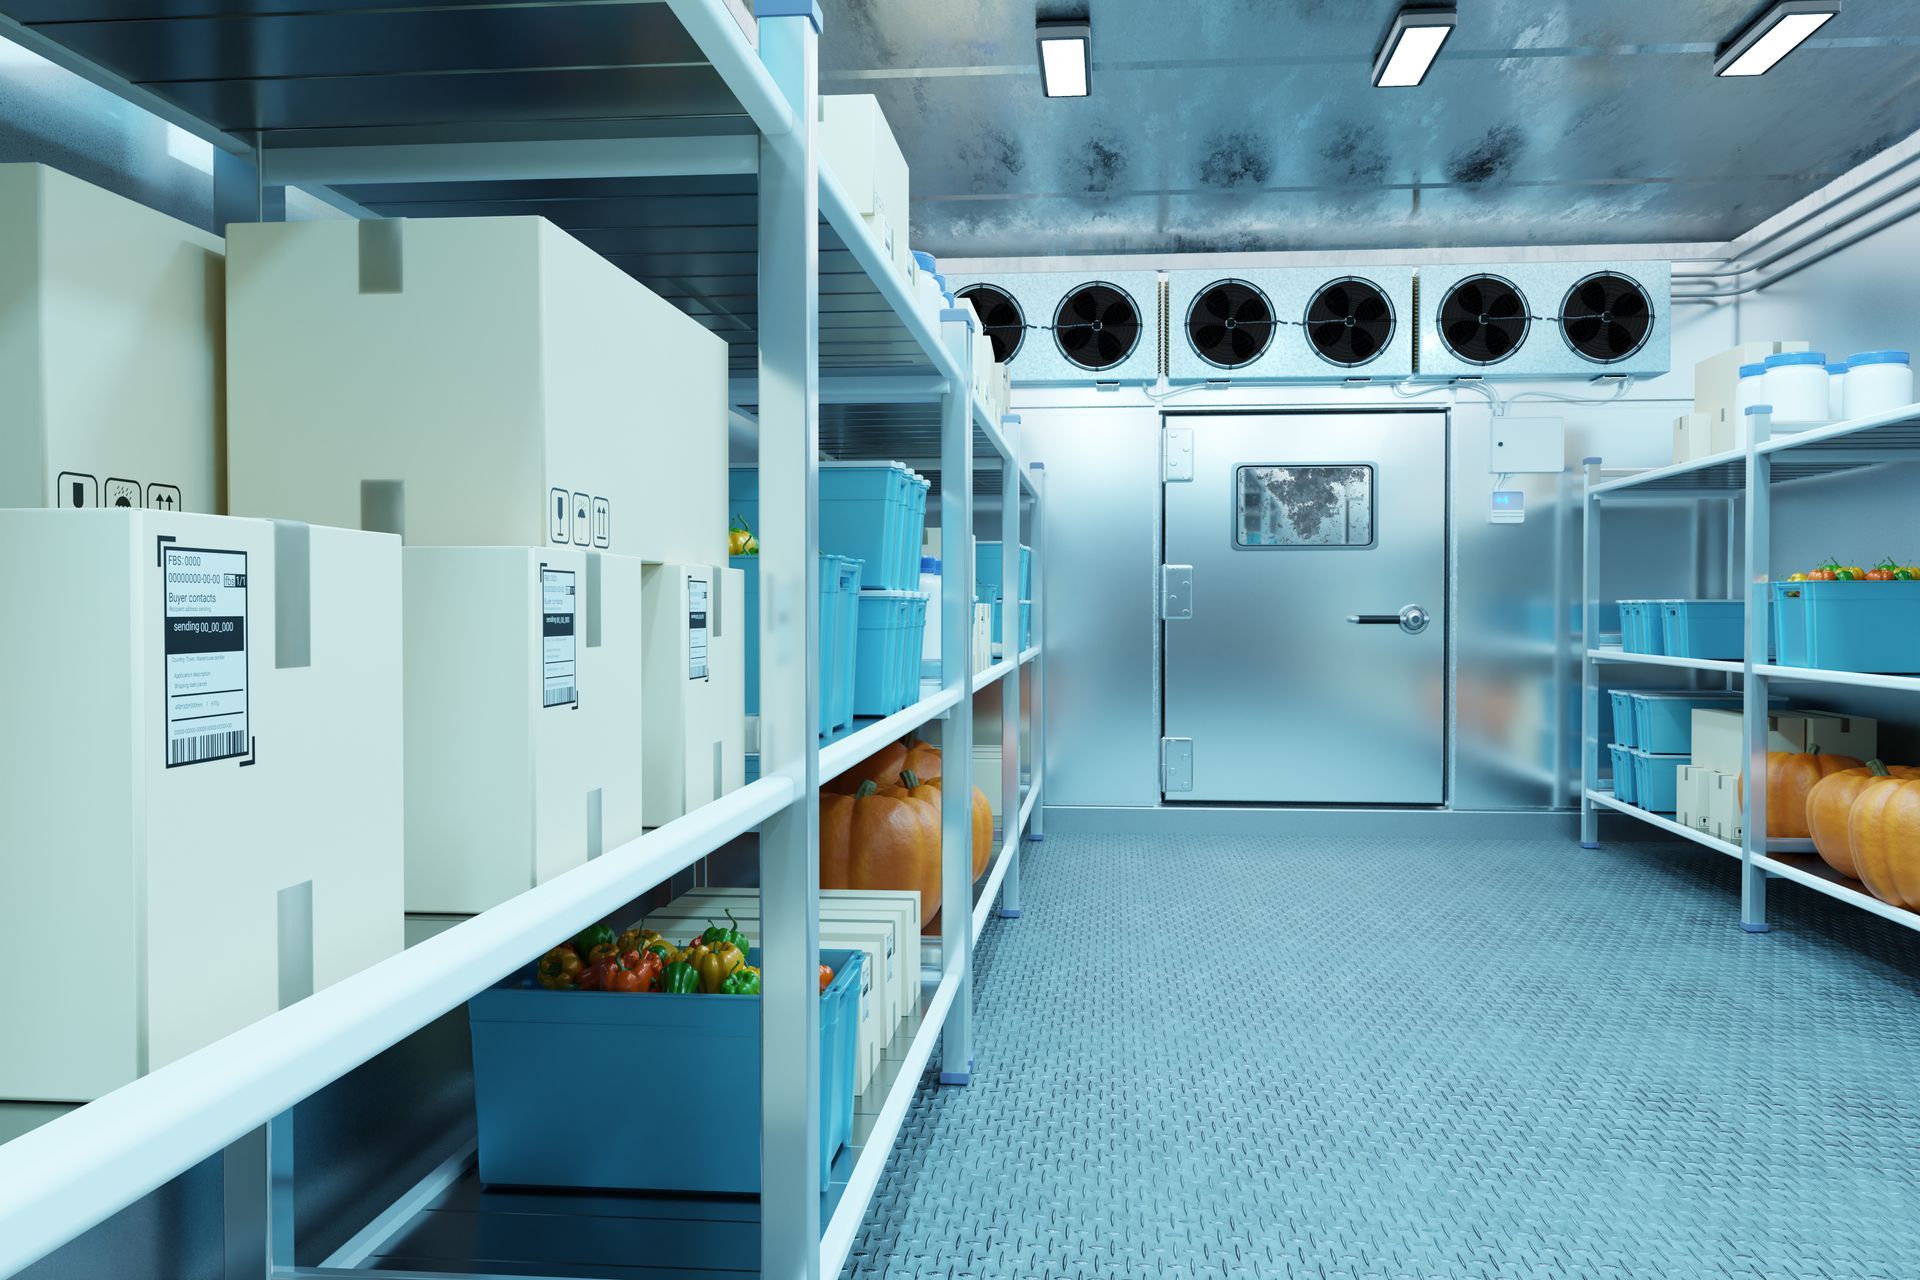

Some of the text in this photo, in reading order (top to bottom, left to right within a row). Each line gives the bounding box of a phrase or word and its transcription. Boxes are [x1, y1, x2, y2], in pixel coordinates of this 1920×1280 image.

[168, 592, 217, 605] Buyer contacts
[173, 621, 200, 633] sending
